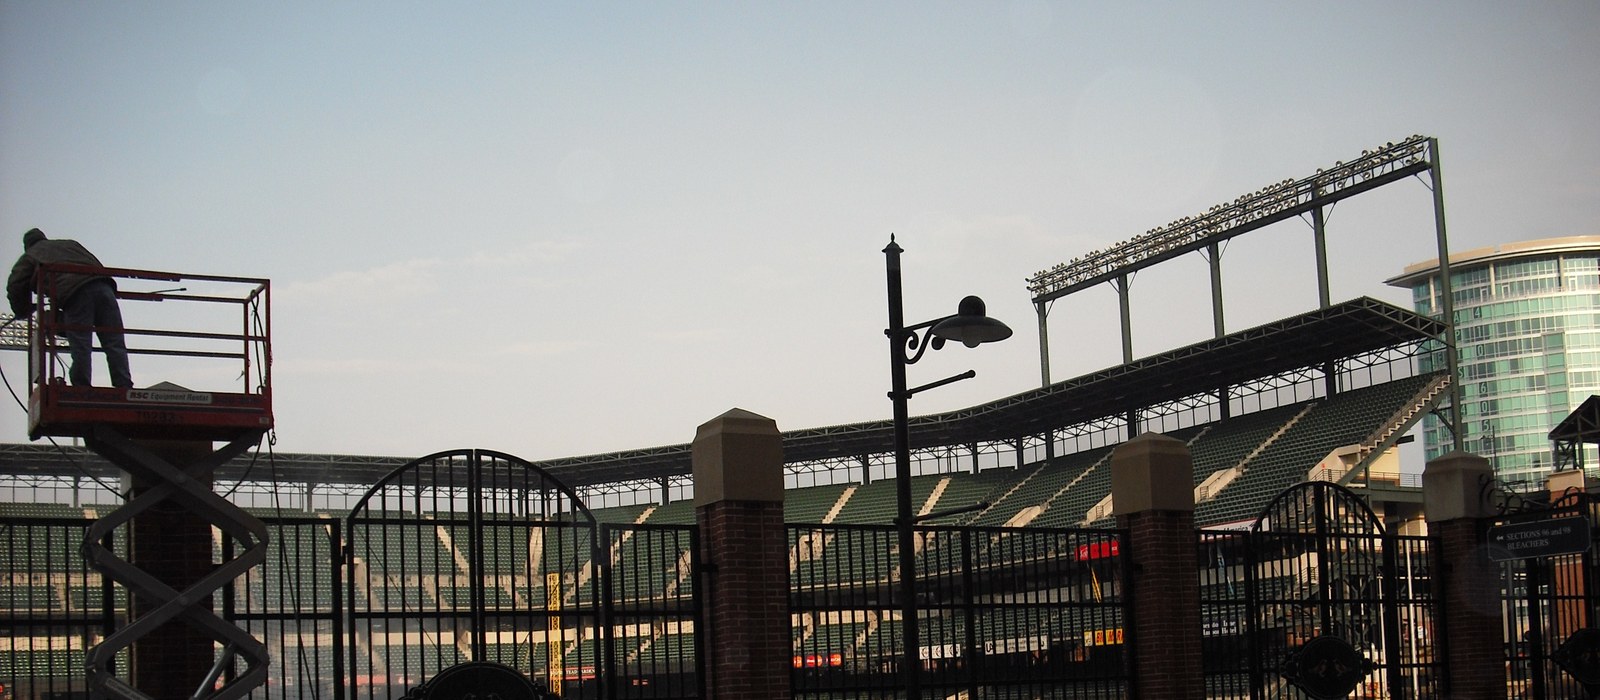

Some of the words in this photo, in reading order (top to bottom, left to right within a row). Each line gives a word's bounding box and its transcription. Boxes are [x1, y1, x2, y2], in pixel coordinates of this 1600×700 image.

[130, 392, 149, 400] RSC
[150, 393, 186, 402] Equipment
[187, 394, 209, 402] Rental
[1506, 530, 1541, 541] SECTIONS
[1551, 528, 1562, 536] and
[1507, 539, 1549, 550] BLEACHERS
